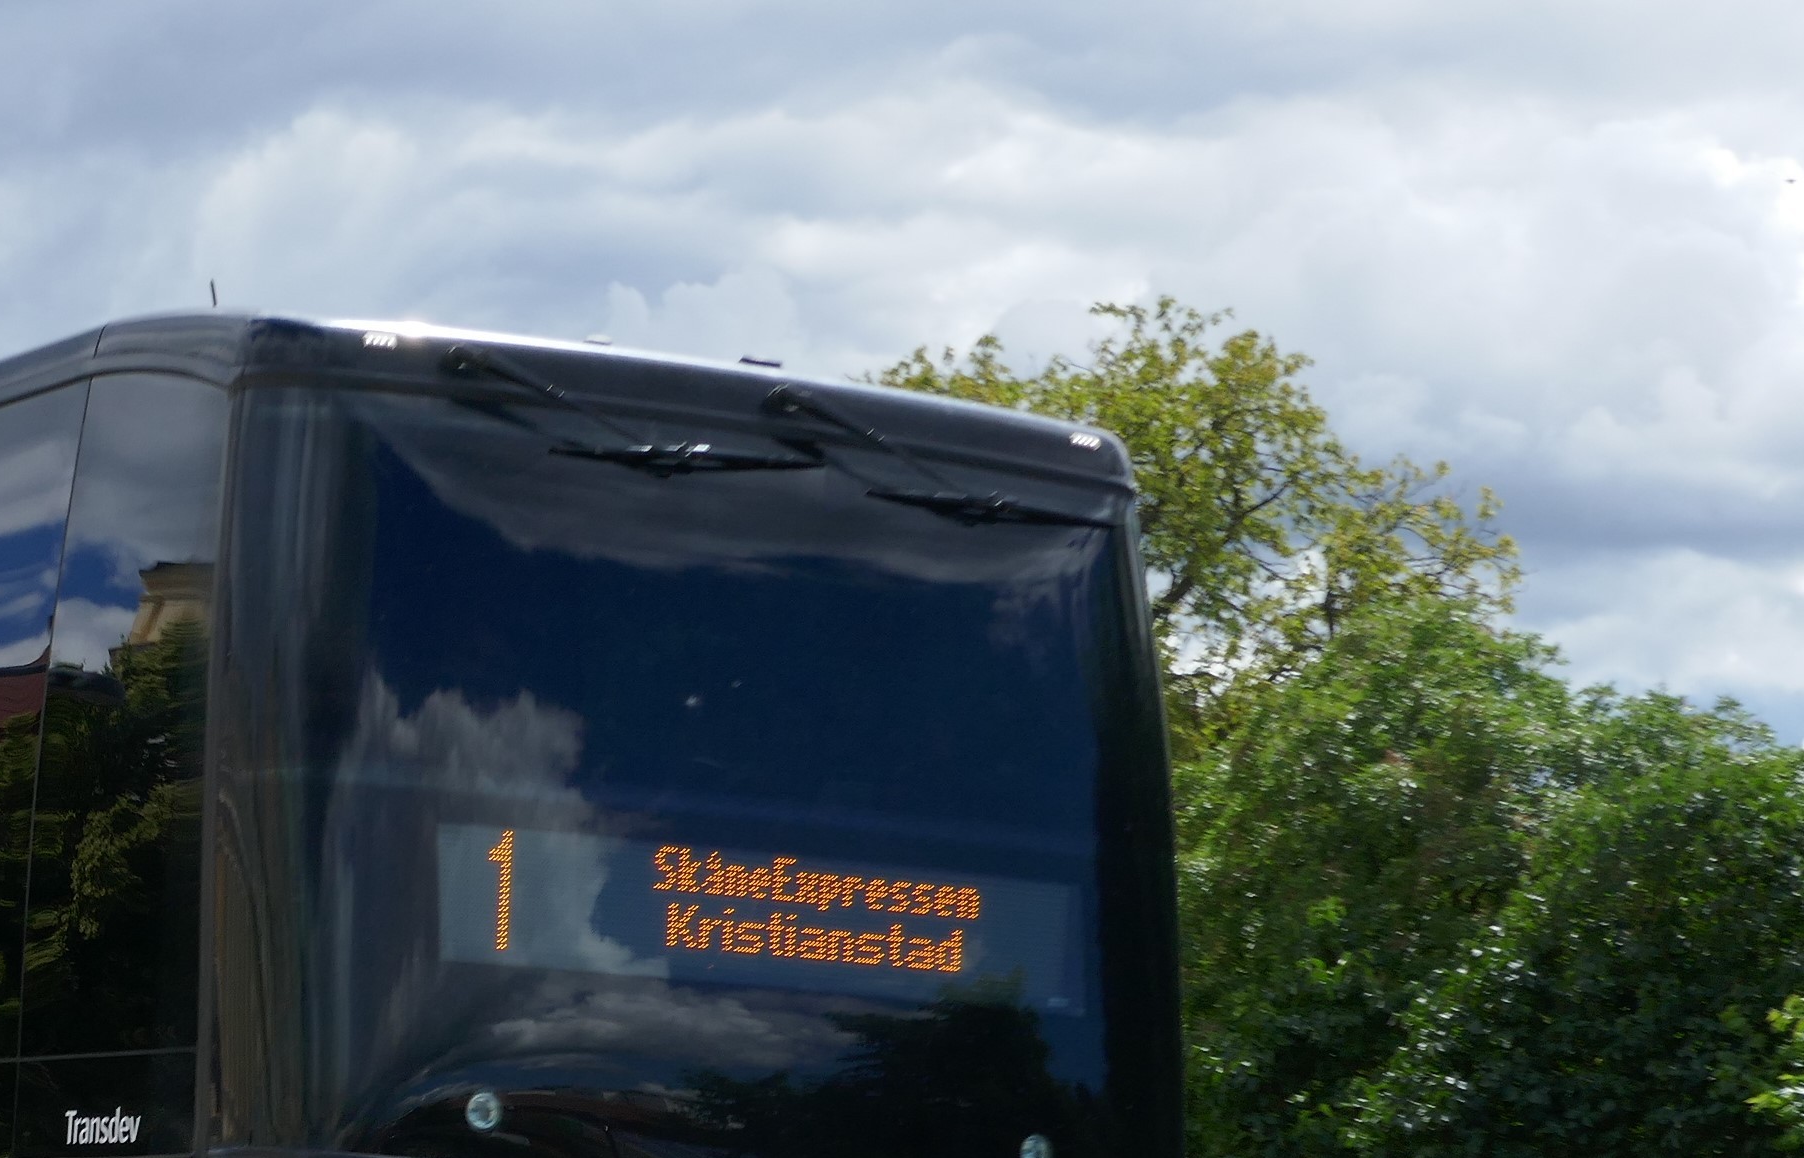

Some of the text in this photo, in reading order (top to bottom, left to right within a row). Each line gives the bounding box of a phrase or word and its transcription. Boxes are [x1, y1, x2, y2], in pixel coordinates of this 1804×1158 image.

[488, 829, 514, 951] 1
[666, 902, 964, 972] Kristianstad
[64, 1105, 142, 1145] Transdev
